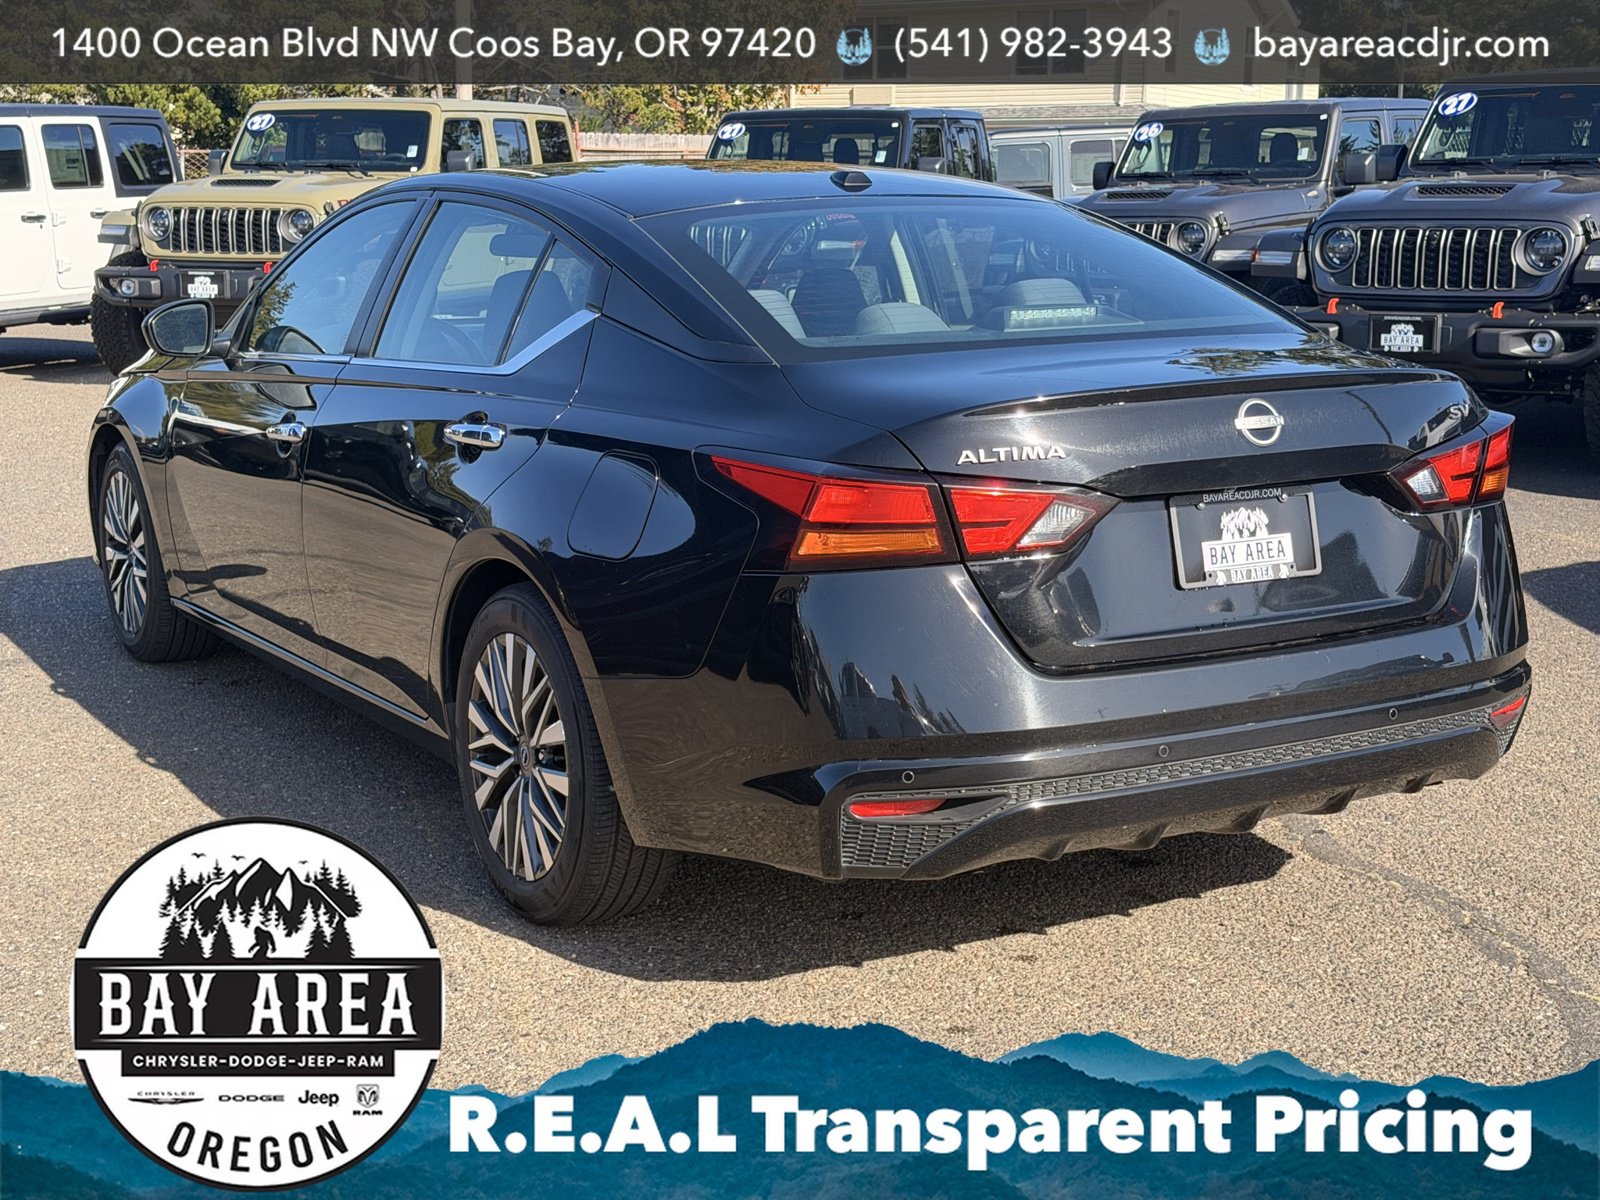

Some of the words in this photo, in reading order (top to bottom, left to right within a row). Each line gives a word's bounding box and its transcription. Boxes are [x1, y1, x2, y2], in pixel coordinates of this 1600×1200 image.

[1444, 92, 1473, 114] 27
[1139, 122, 1161, 140] 26
[1384, 336, 1397, 344] BAY
[1400, 336, 1420, 345] AREA
[1450, 404, 1469, 419] SV
[1235, 415, 1284, 429] SSAN
[957, 445, 1066, 466] ALTIMA
[1203, 488, 1282, 503] BAYAREACDJR.COM
[1210, 545, 1236, 565] BAY
[1246, 540, 1286, 562] AREA
[1231, 568, 1247, 582] BAY
[1251, 565, 1275, 580] AREA
